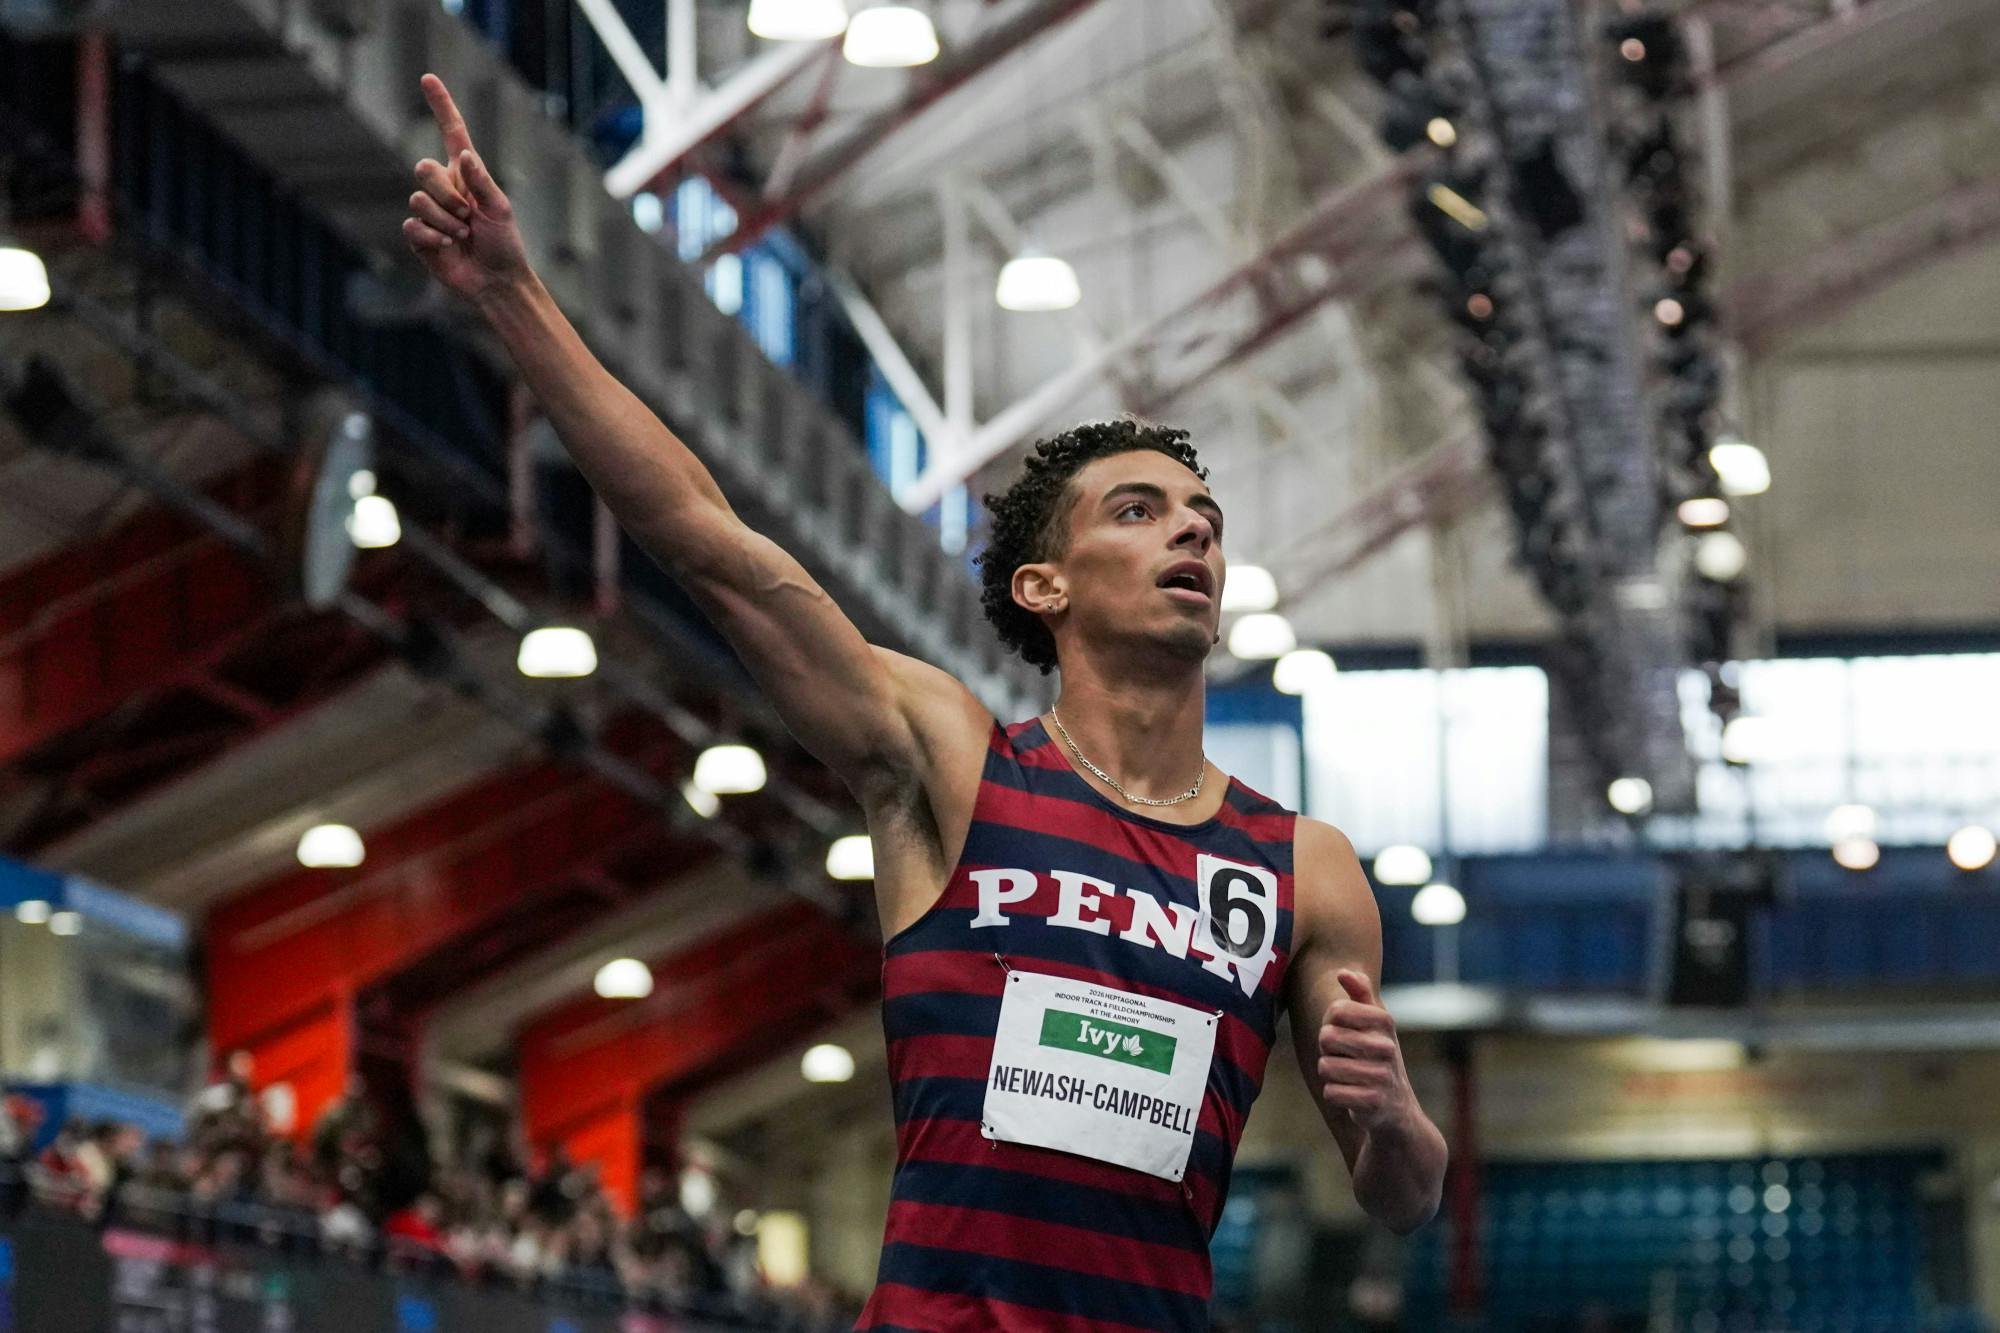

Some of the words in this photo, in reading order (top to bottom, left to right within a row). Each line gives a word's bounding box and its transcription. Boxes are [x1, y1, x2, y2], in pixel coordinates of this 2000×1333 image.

[1210, 868, 1266, 958] 6
[969, 868, 1277, 998] PEN
[1055, 992, 1080, 1002] INDOOR
[1081, 996, 1102, 1007] TRACK
[1126, 1007, 1176, 1025] CHAMPIONSHIPS
[1090, 1008, 1099, 1016] AT
[1100, 1010, 1112, 1019] THE
[1113, 1013, 1140, 1025] ARMORY
[1105, 993, 1146, 1008] HEPTAGONAL
[1077, 1020, 1122, 1055] Ivy
[992, 1065, 1192, 1136] NEWASH-CAMPBELL
